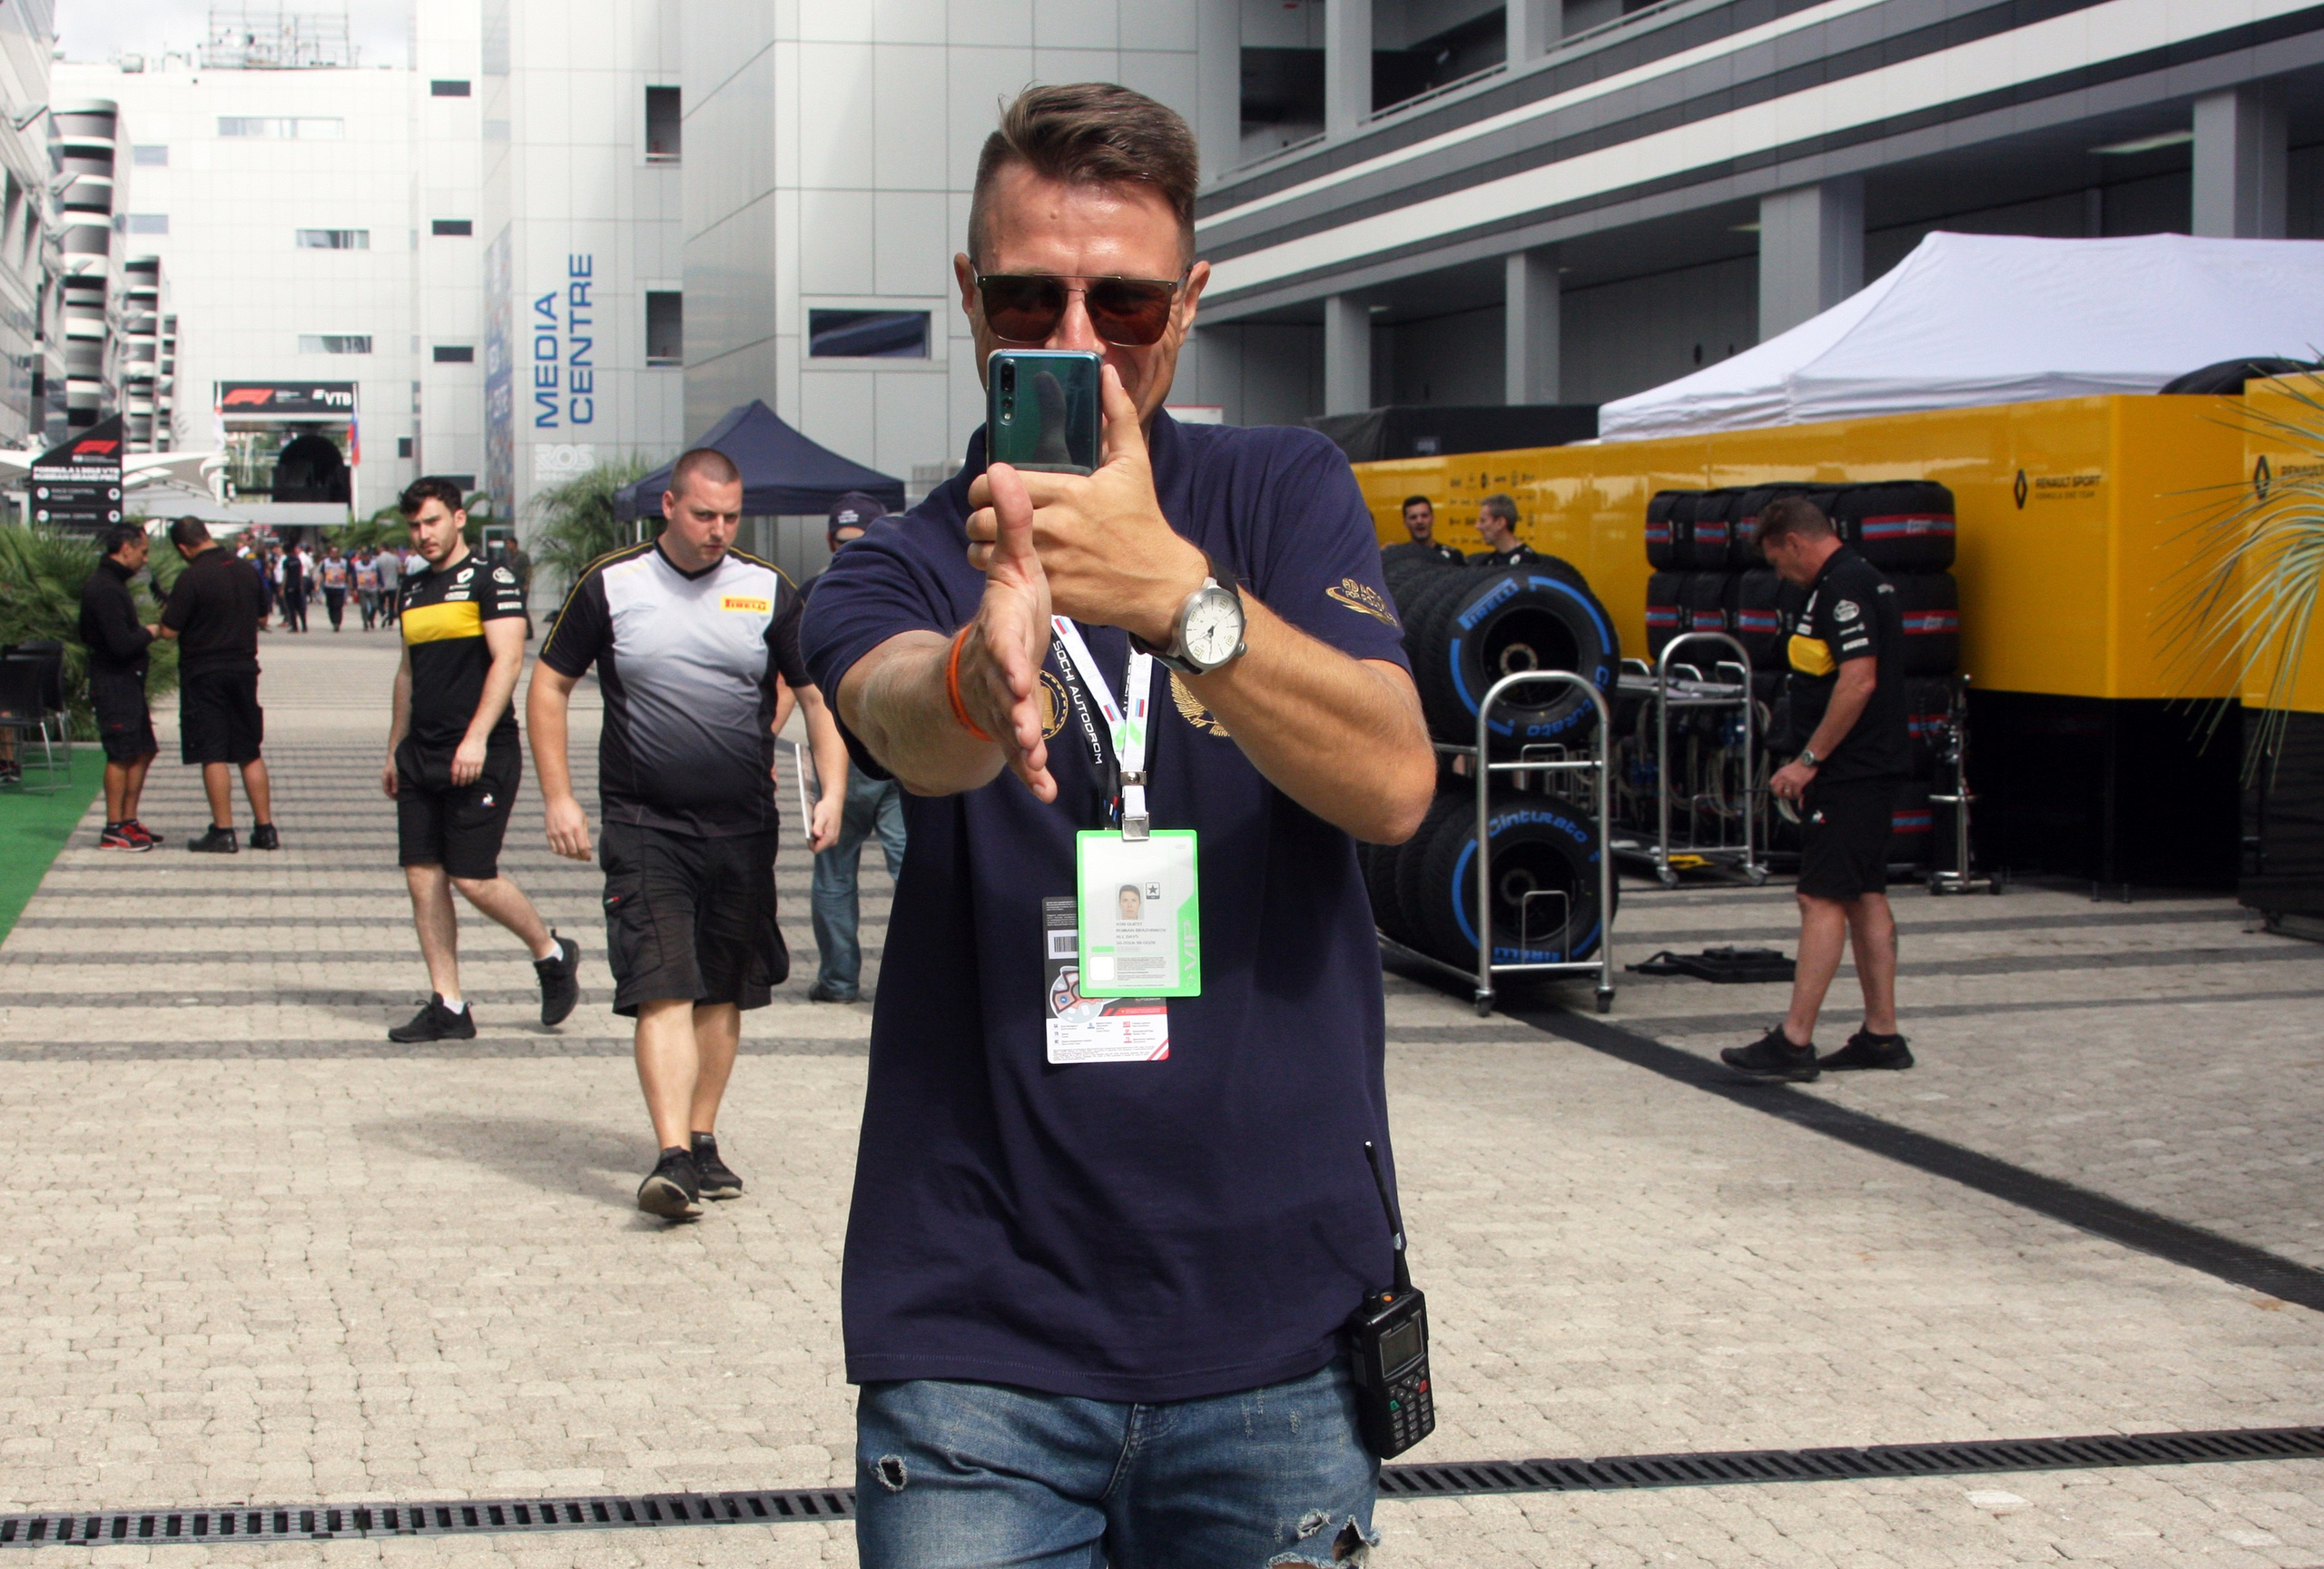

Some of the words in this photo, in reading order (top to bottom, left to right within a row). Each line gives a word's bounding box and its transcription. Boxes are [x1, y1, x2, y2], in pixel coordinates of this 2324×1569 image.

[534, 291, 558, 428] MEDIA
[569, 253, 593, 424] CENTRE
[325, 391, 353, 406] VTB
[2072, 474, 2102, 487] SPORT
[725, 598, 767, 611] PIRELLI
[1457, 577, 1521, 631] PIRELLI
[1053, 640, 1076, 682] SOCHI
[1069, 685, 1103, 765] AUTODROM
[1183, 920, 1196, 972] VIP
